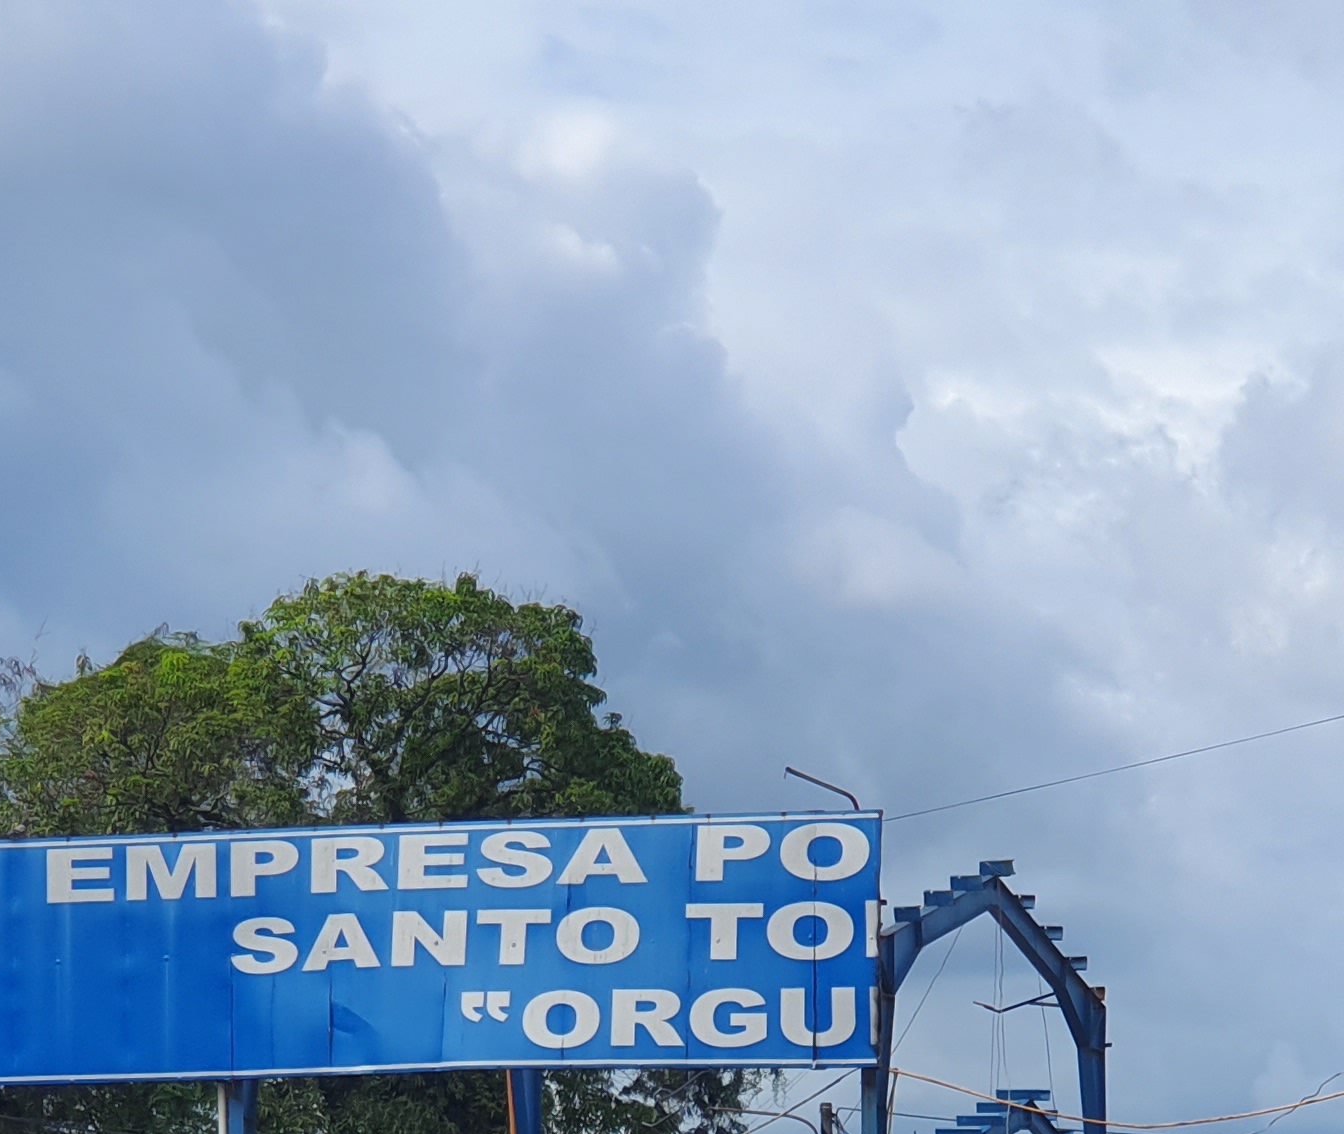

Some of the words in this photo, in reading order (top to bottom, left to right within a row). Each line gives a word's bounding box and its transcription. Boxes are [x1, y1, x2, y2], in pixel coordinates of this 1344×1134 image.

[47, 828, 648, 903] EMPRESA
[696, 823, 870, 882] PO
[230, 907, 640, 975] SANTO
[685, 900, 878, 961] TO
[461, 986, 878, 1050] “ORGU
